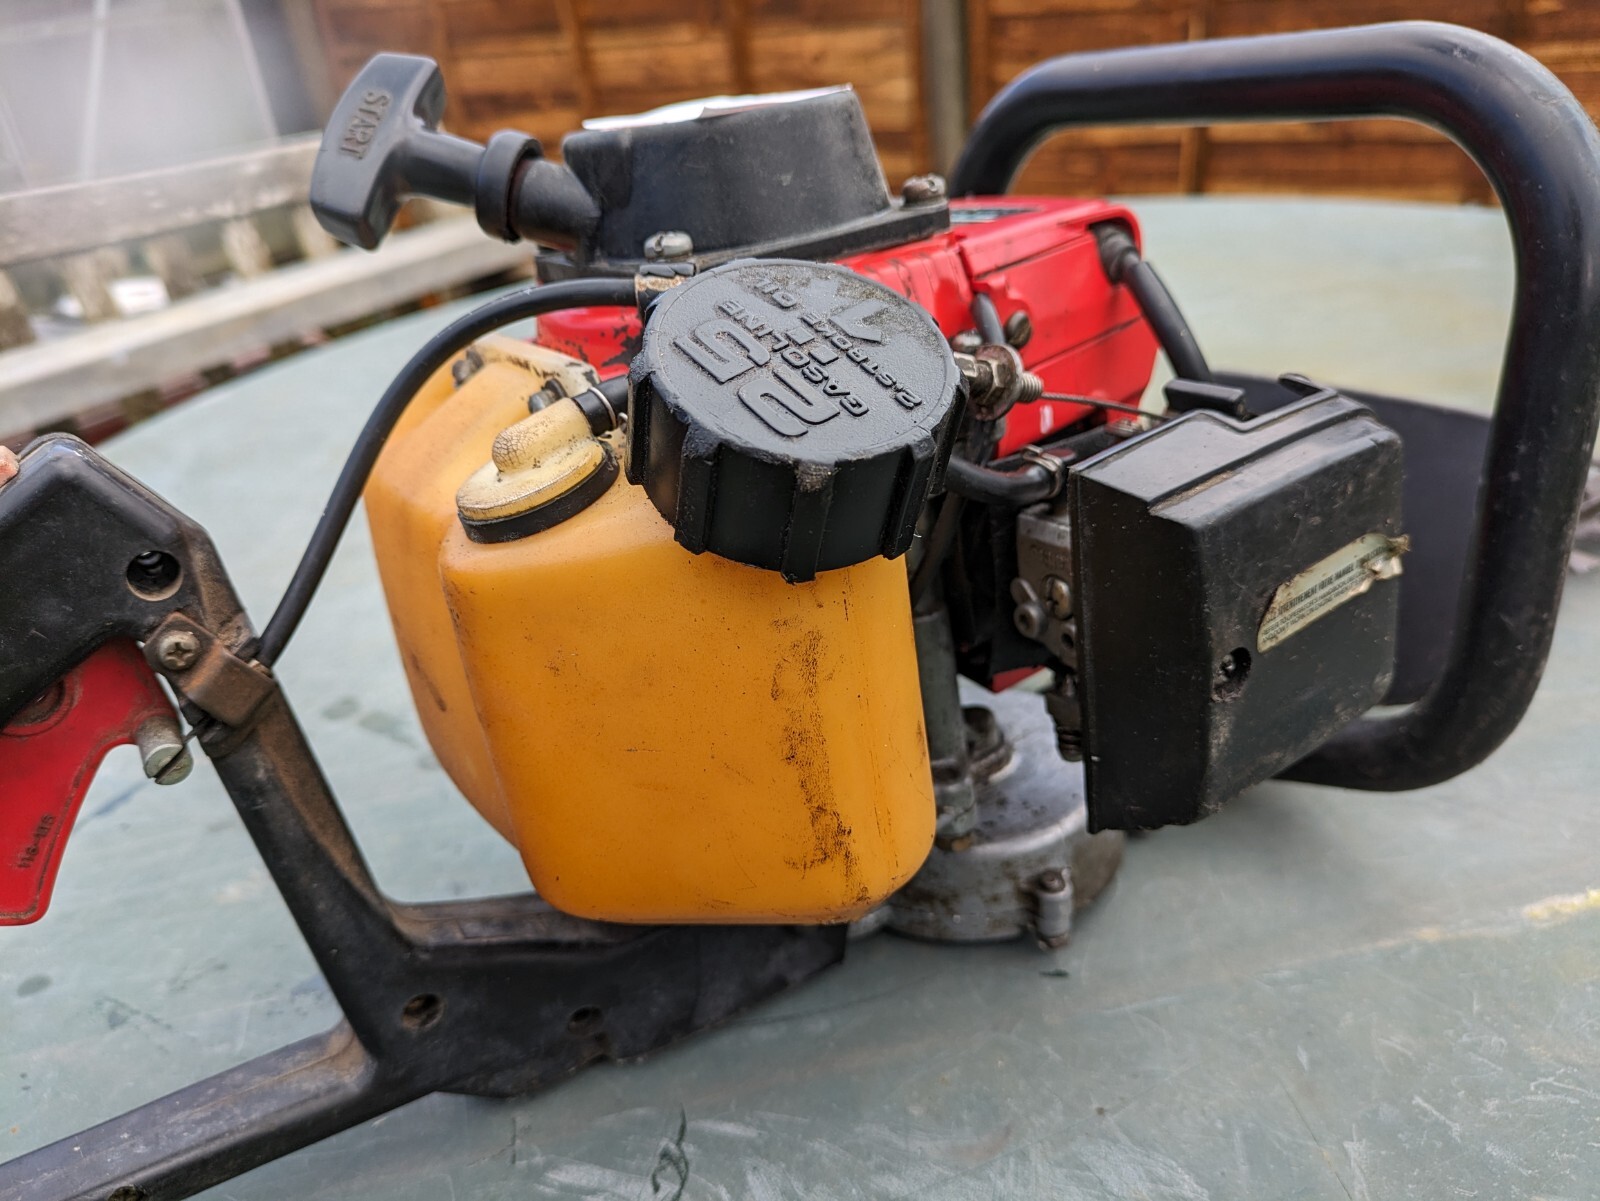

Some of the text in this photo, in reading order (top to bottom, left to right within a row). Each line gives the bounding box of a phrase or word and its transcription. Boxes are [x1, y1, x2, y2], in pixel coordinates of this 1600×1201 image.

[340, 91, 389, 160] START
[754, 277, 799, 309] OIL
[673, 318, 841, 438] 25
[717, 299, 870, 417] GASOLINE
